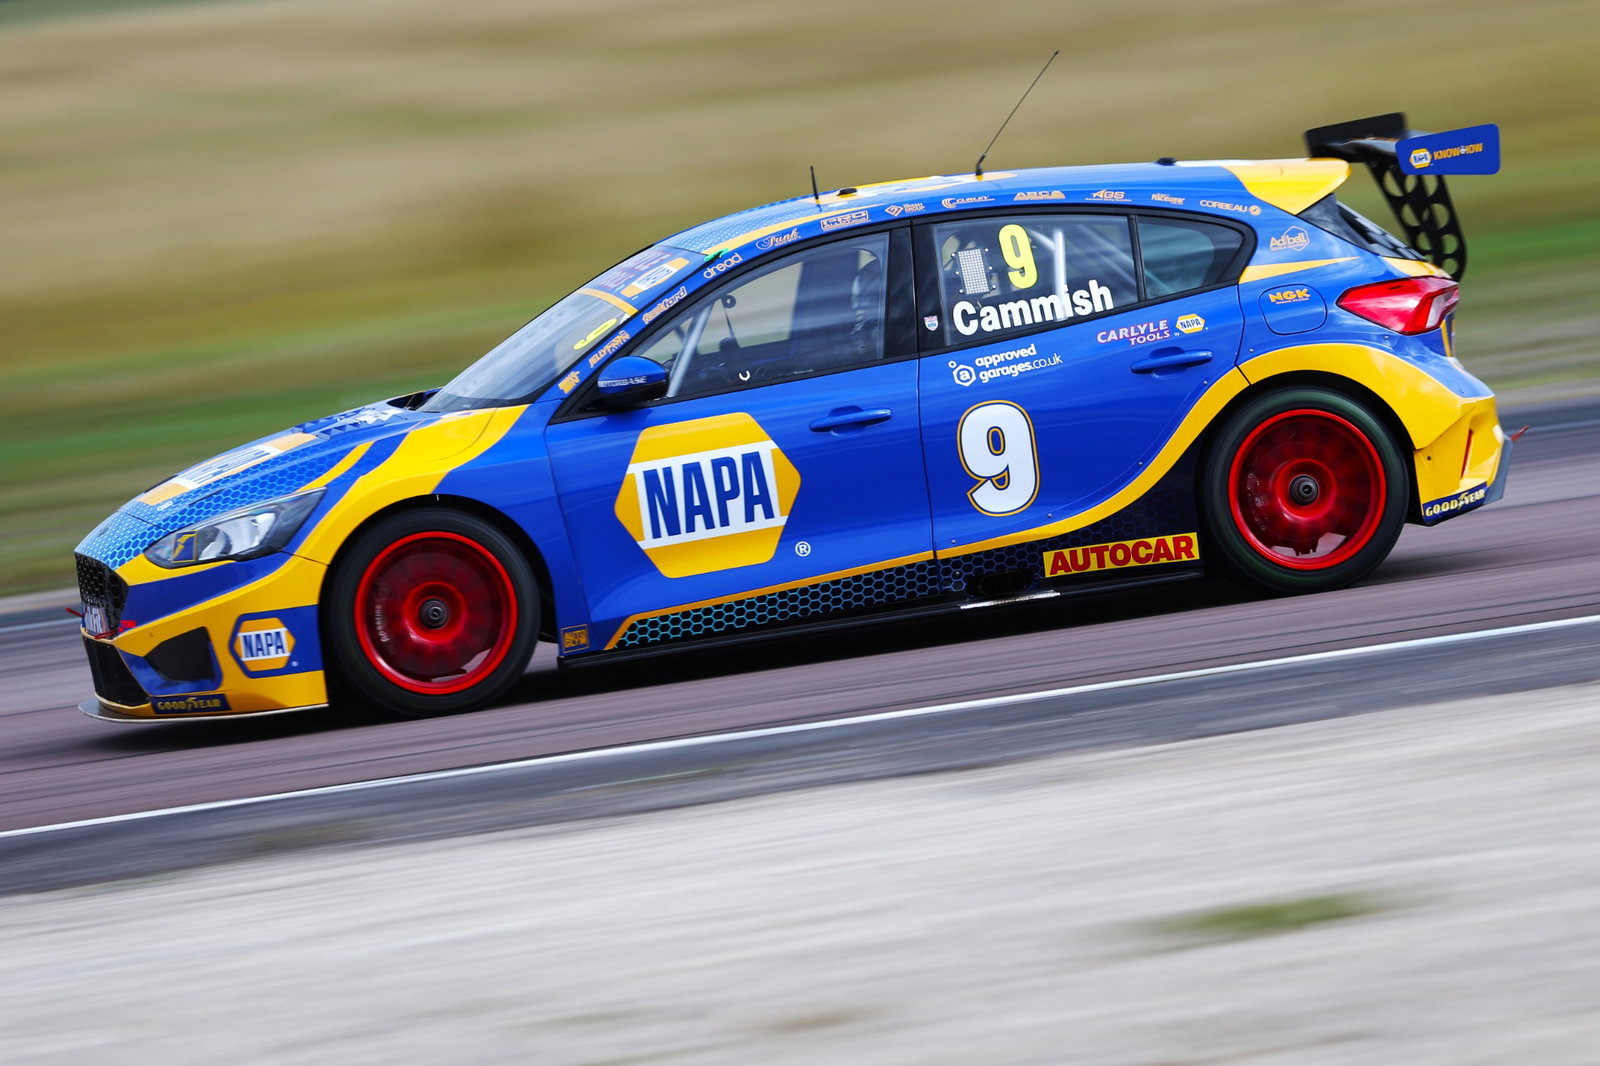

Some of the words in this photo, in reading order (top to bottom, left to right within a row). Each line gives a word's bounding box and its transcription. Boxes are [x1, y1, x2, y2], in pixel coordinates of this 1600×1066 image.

[1200, 199, 1248, 213] CORBEAU
[703, 253, 743, 279] dread
[998, 224, 1038, 289] 9
[953, 280, 1114, 336] Cammish
[1268, 288, 1310, 303] NGK
[1096, 319, 1168, 343] CARLYLE
[1180, 318, 1201, 329] NAPA
[1129, 330, 1170, 346] TOOLS
[975, 344, 1037, 367] approved
[979, 353, 1063, 383] garages.co.uk
[957, 400, 1040, 516] 9
[643, 451, 775, 540] NAPA
[1425, 488, 1486, 517] GOODYEAR
[1049, 535, 1195, 576] AUTOCAR
[239, 630, 287, 658] NAPA
[157, 697, 221, 710] GOODYEAR
